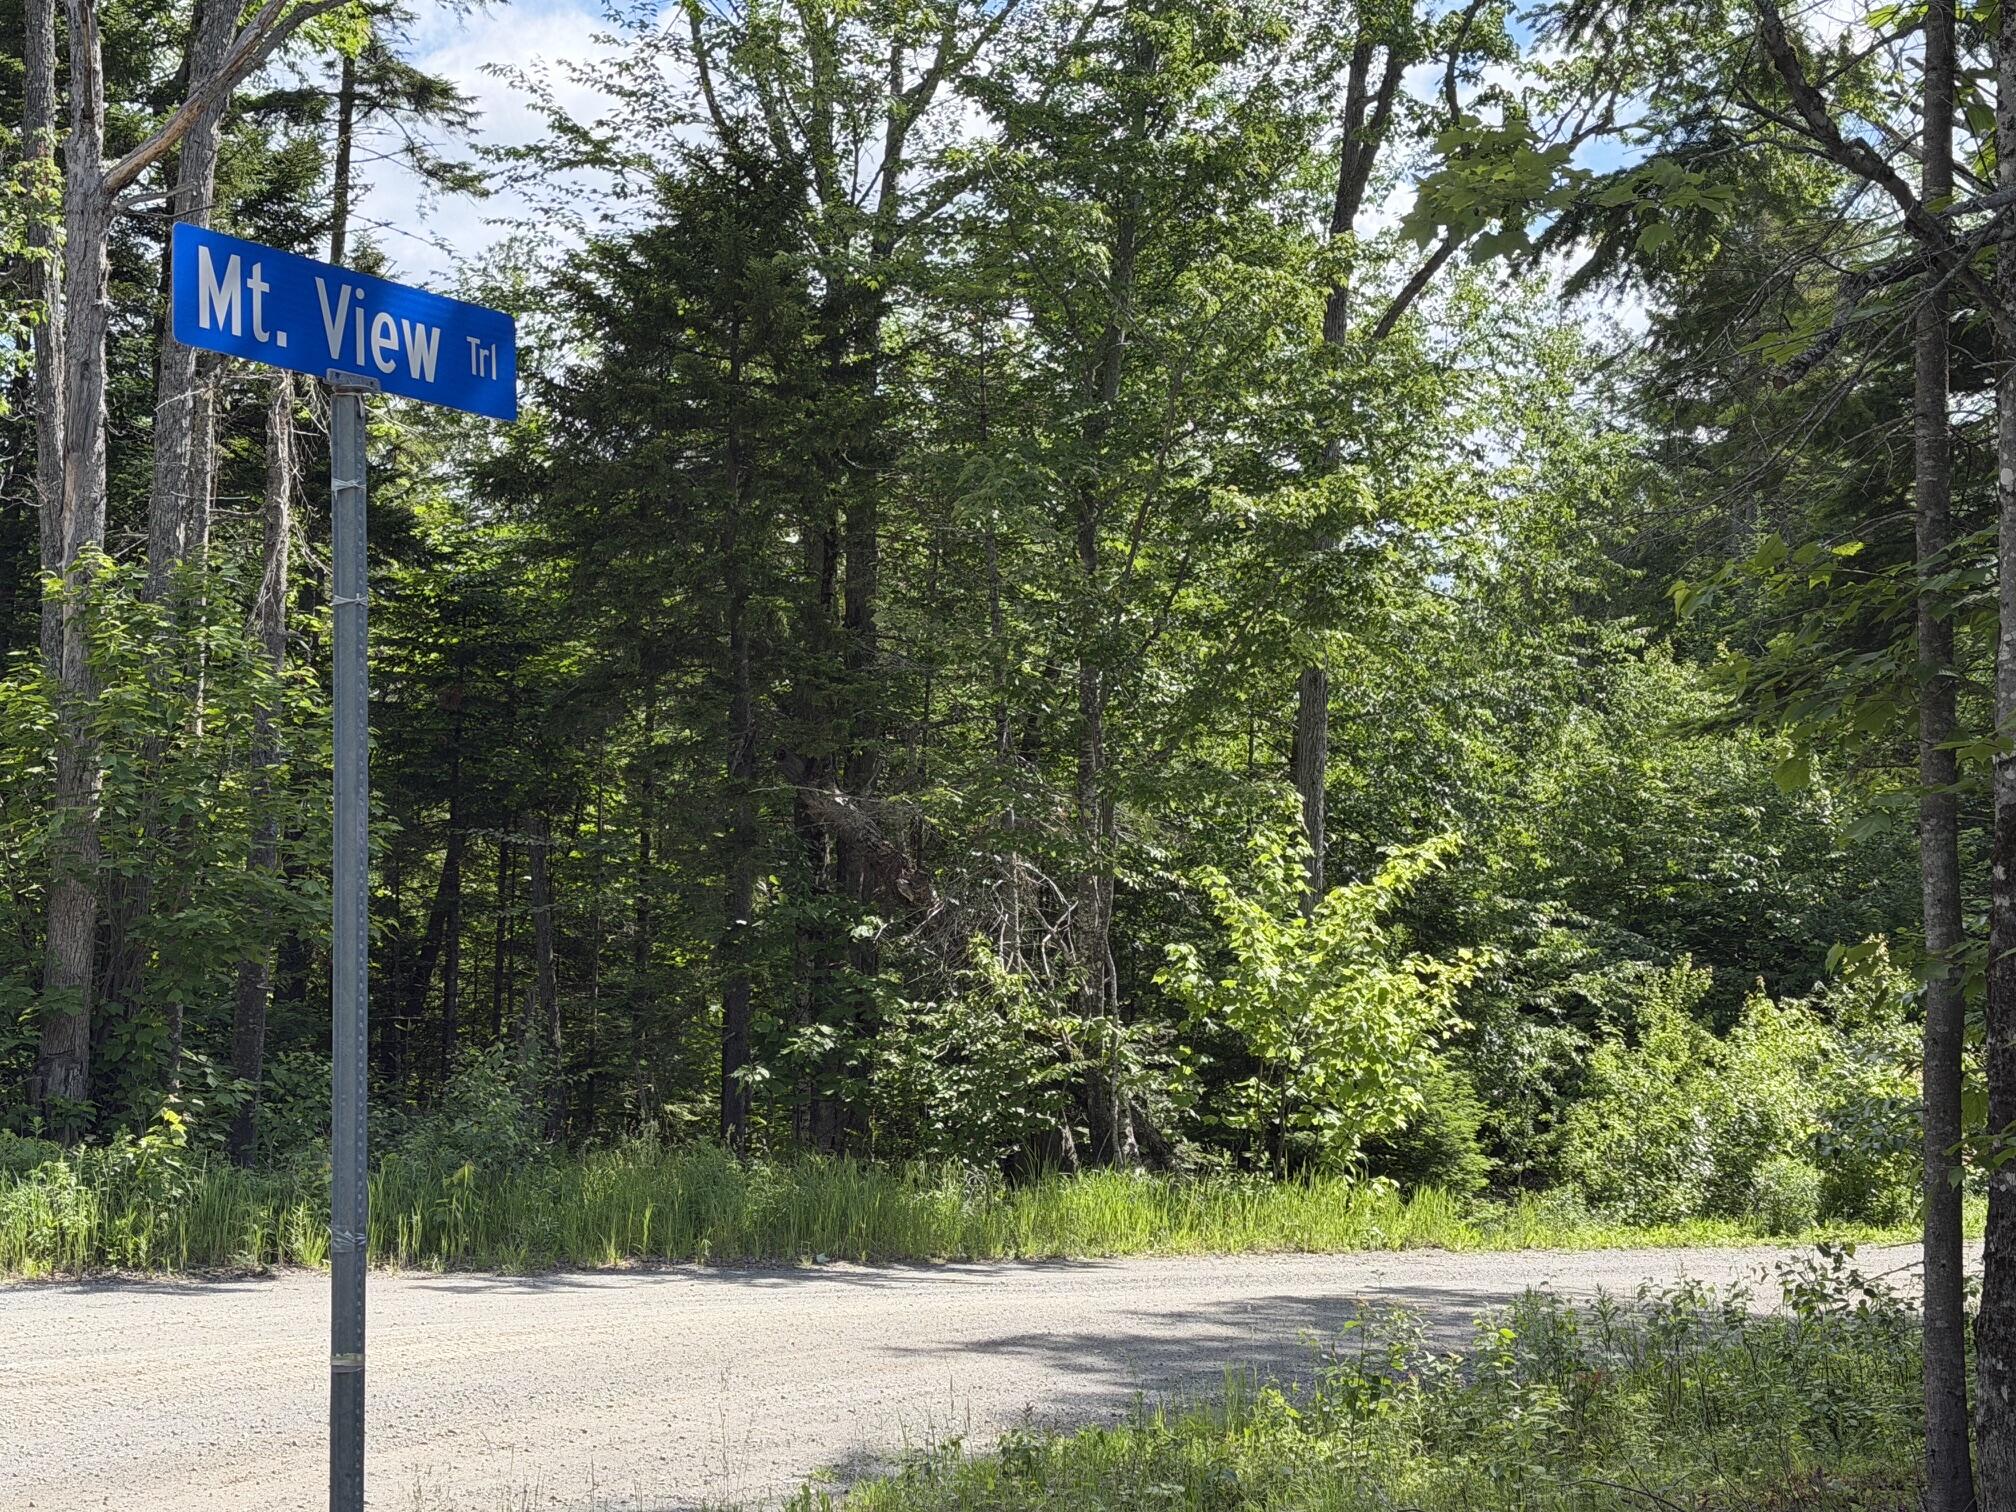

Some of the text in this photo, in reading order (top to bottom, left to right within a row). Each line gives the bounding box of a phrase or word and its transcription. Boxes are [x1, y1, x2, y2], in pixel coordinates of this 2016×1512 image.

[198, 245, 497, 383] Mt. View Trl
